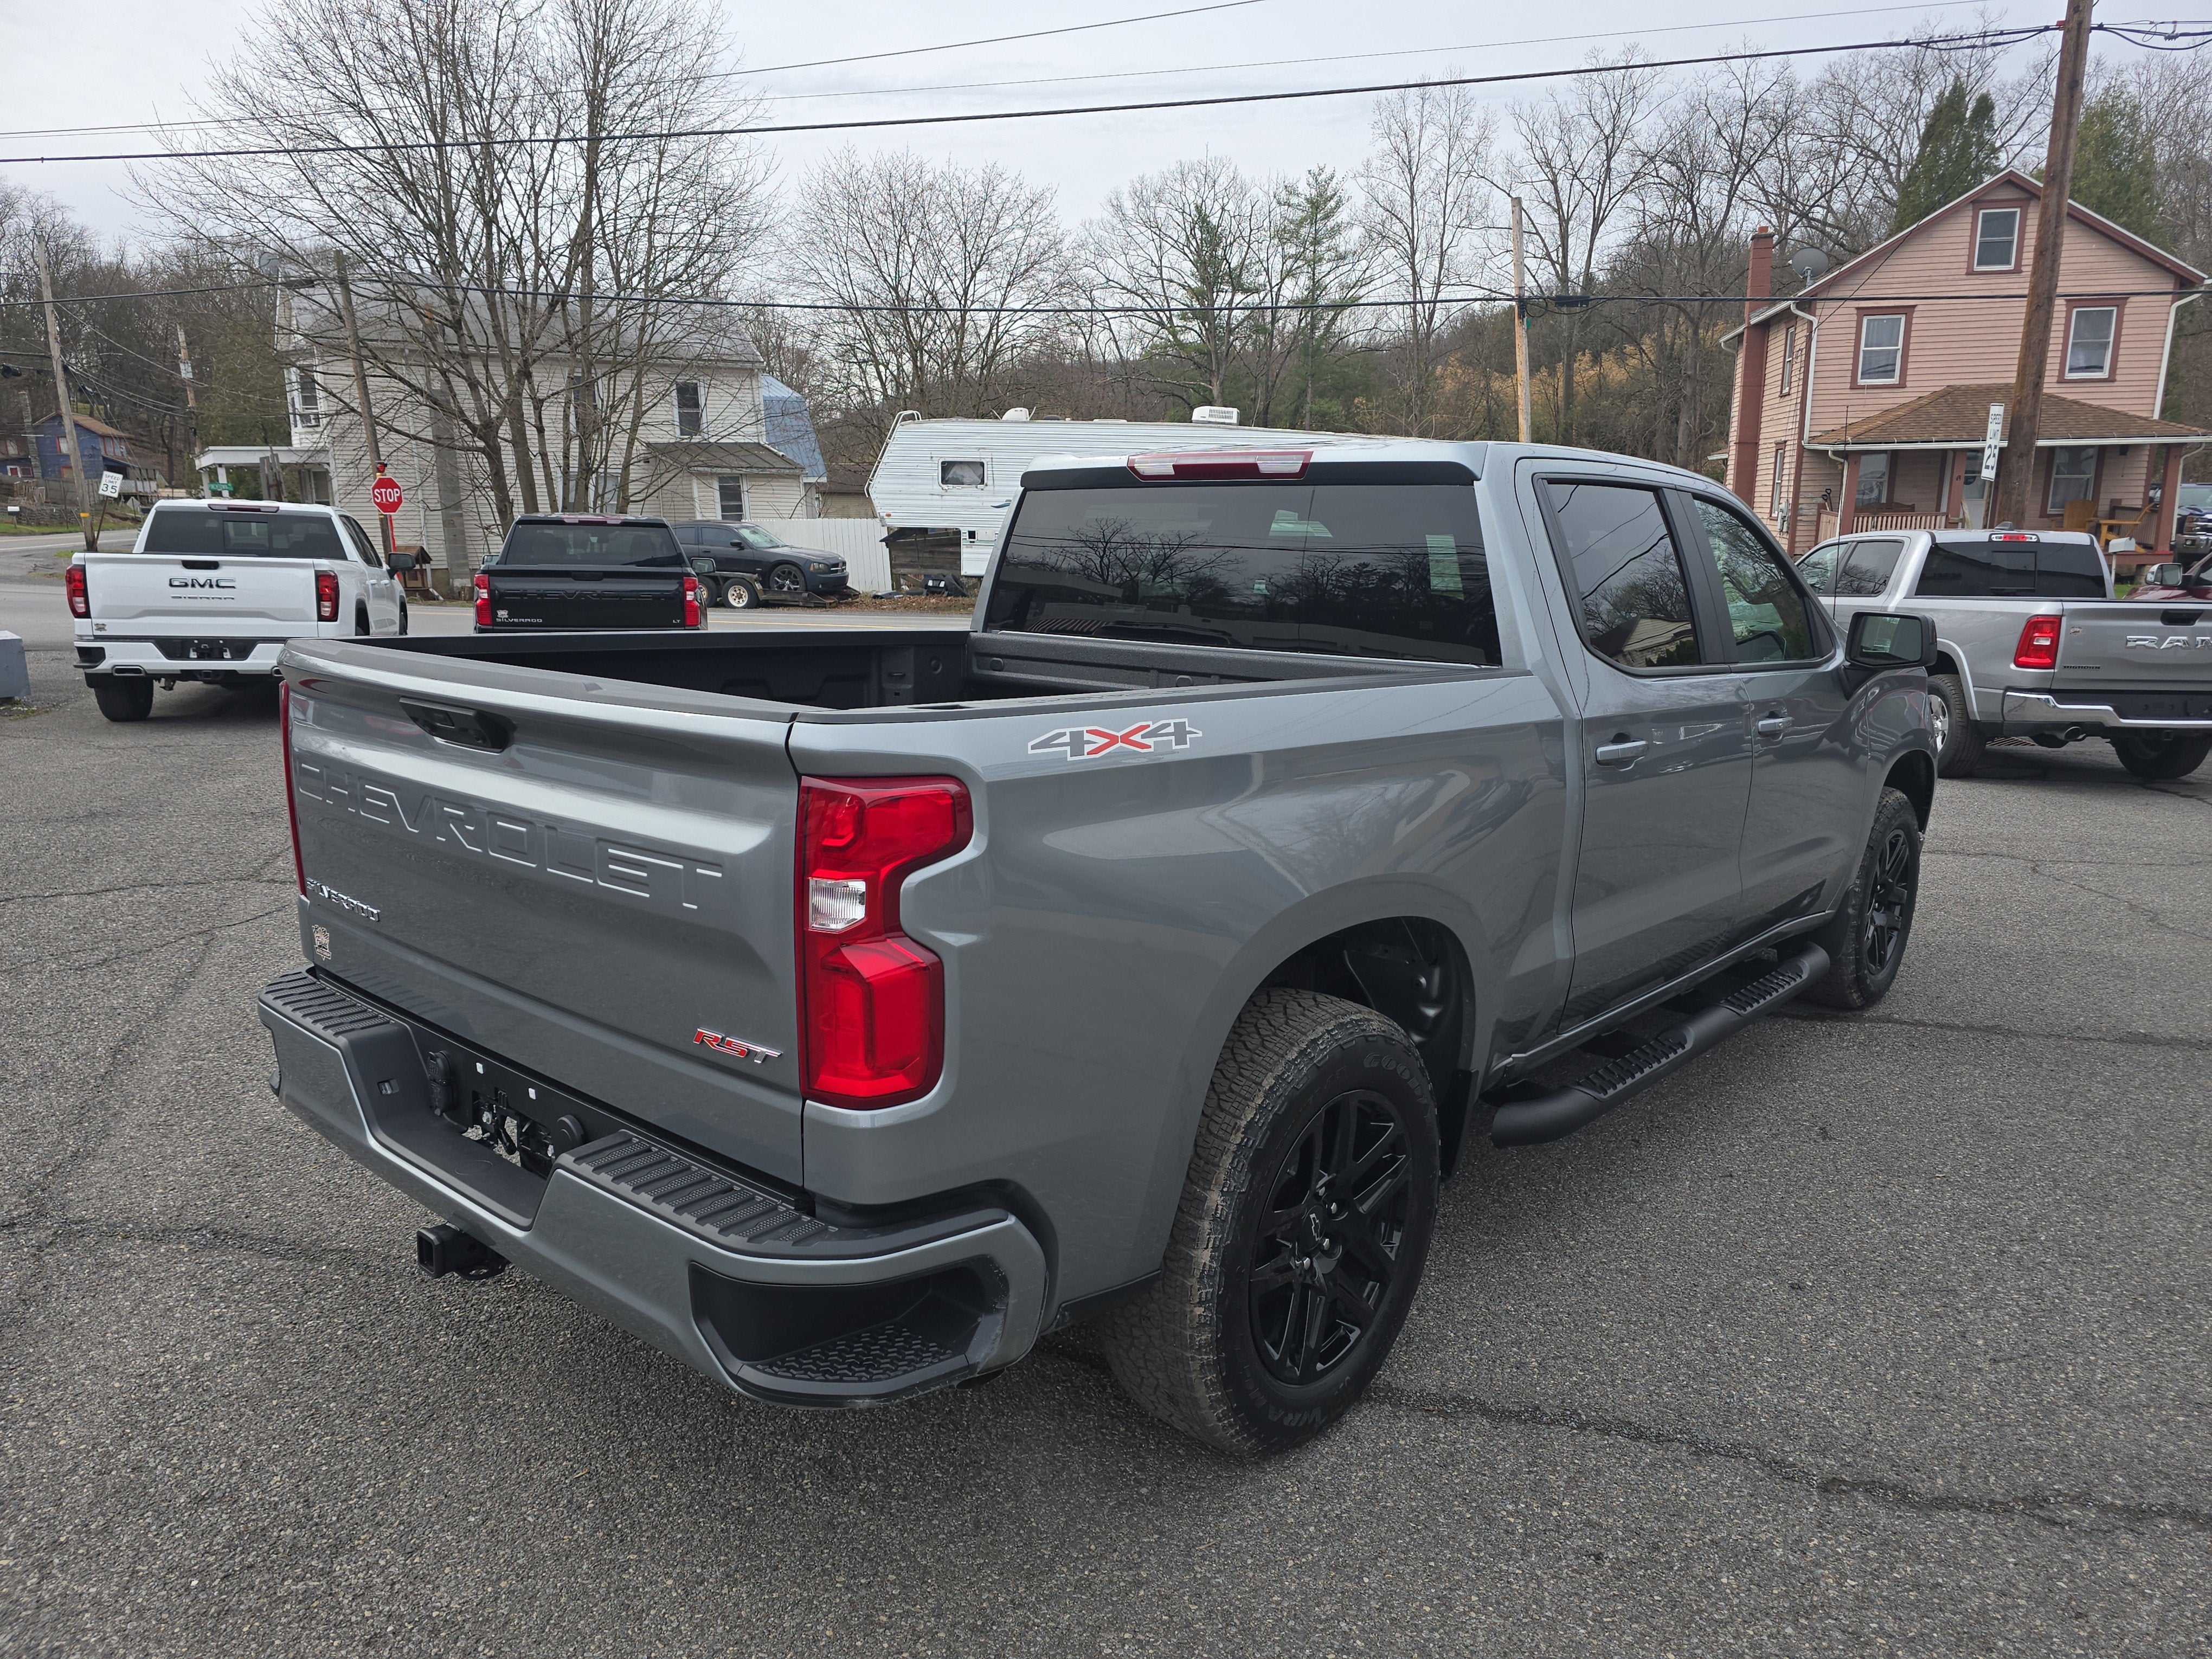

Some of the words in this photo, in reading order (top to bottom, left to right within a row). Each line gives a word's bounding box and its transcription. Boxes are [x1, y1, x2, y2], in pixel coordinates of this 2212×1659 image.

[1984, 444, 1997, 471] 25
[101, 484, 117, 493] 35
[374, 488, 401, 503] STOP
[169, 577, 236, 589] GMC
[504, 589, 674, 601] CHEVROLET
[1027, 718, 1203, 762] 4X4
[298, 761, 724, 910] CHEVROLET
[305, 877, 381, 922] SILVERADO
[692, 1027, 784, 1064] RST
